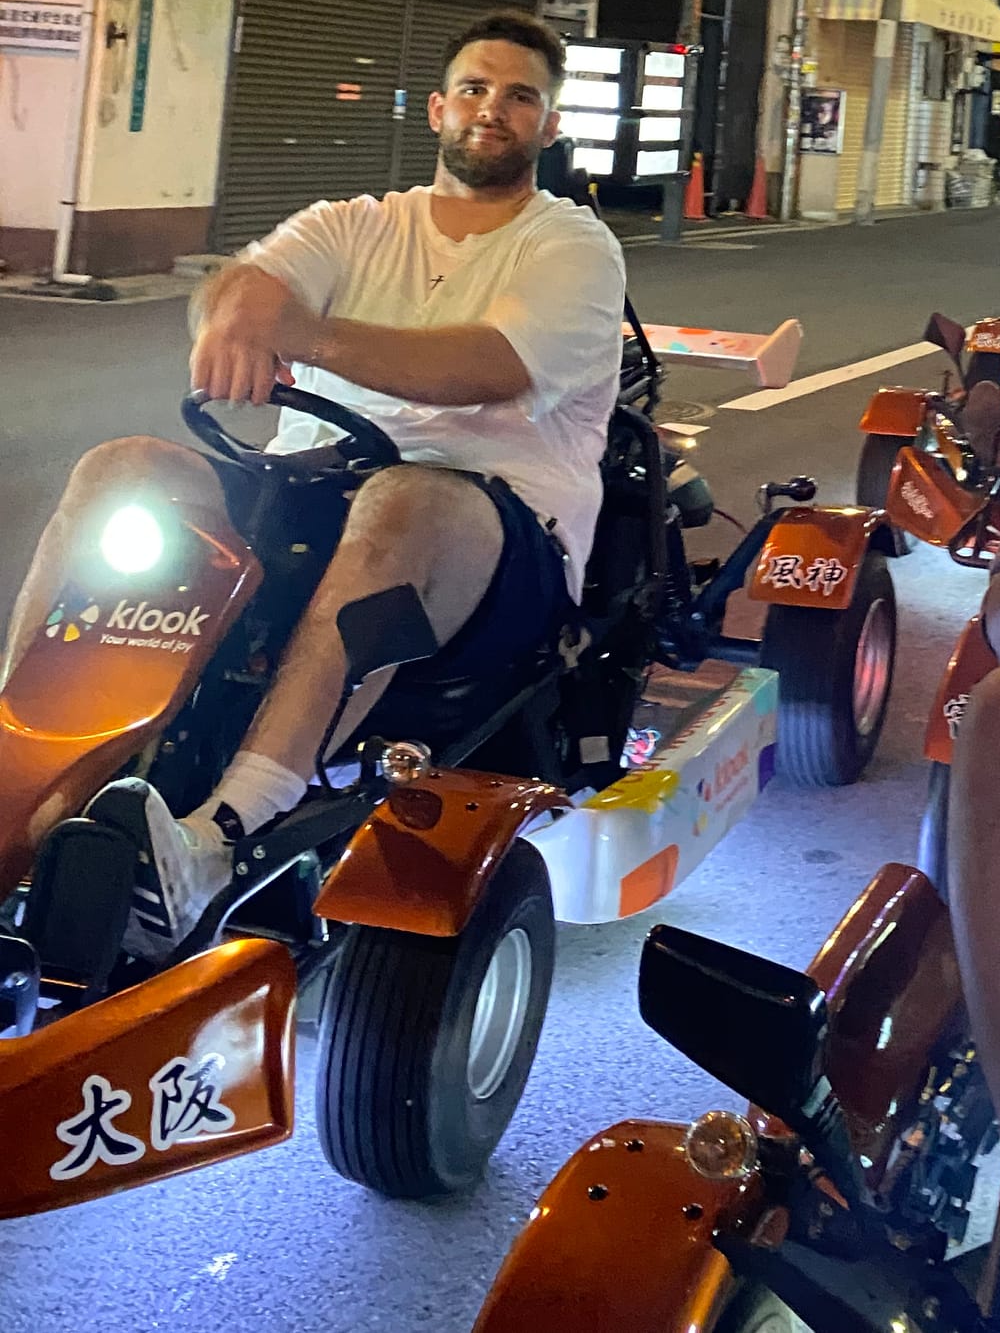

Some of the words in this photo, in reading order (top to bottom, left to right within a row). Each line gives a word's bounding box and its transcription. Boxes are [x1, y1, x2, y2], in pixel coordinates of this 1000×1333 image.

[762, 555, 848, 596] 風神
[106, 599, 211, 636] klook
[100, 634, 127, 646] Your
[127, 637, 160, 649] world
[171, 641, 194, 653] joy
[49, 1052, 236, 1181] 大阪
